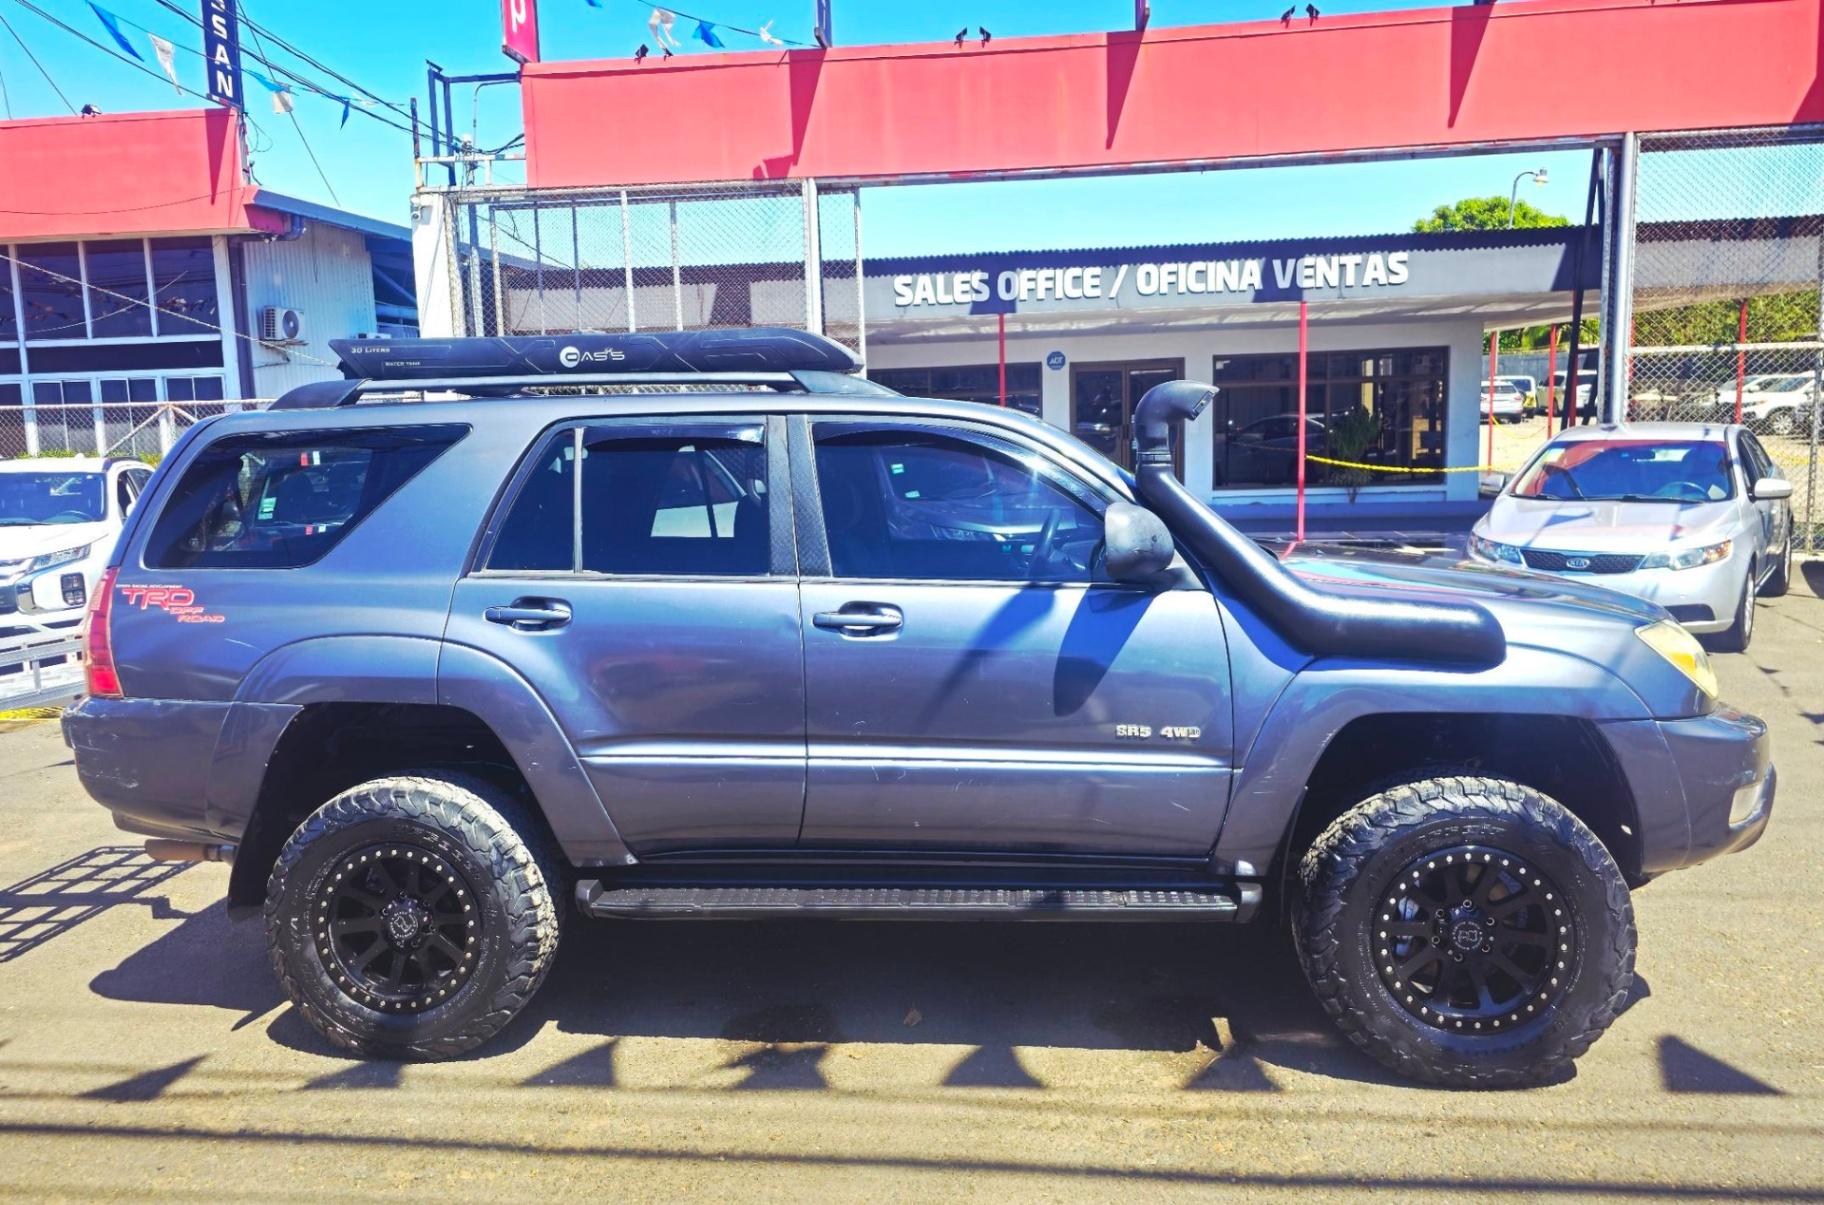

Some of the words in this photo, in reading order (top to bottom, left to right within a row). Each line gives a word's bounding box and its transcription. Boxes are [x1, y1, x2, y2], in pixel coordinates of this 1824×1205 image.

[893, 272, 990, 306] SALES
[997, 267, 1101, 301] OFFICE
[1136, 259, 1263, 296] OFICINA
[1272, 252, 1409, 289] VENTAS
[122, 588, 194, 610] TRD
[178, 615, 225, 623] ROAD
[1116, 724, 1152, 737] SR5
[1160, 726, 1200, 738] 4WD
